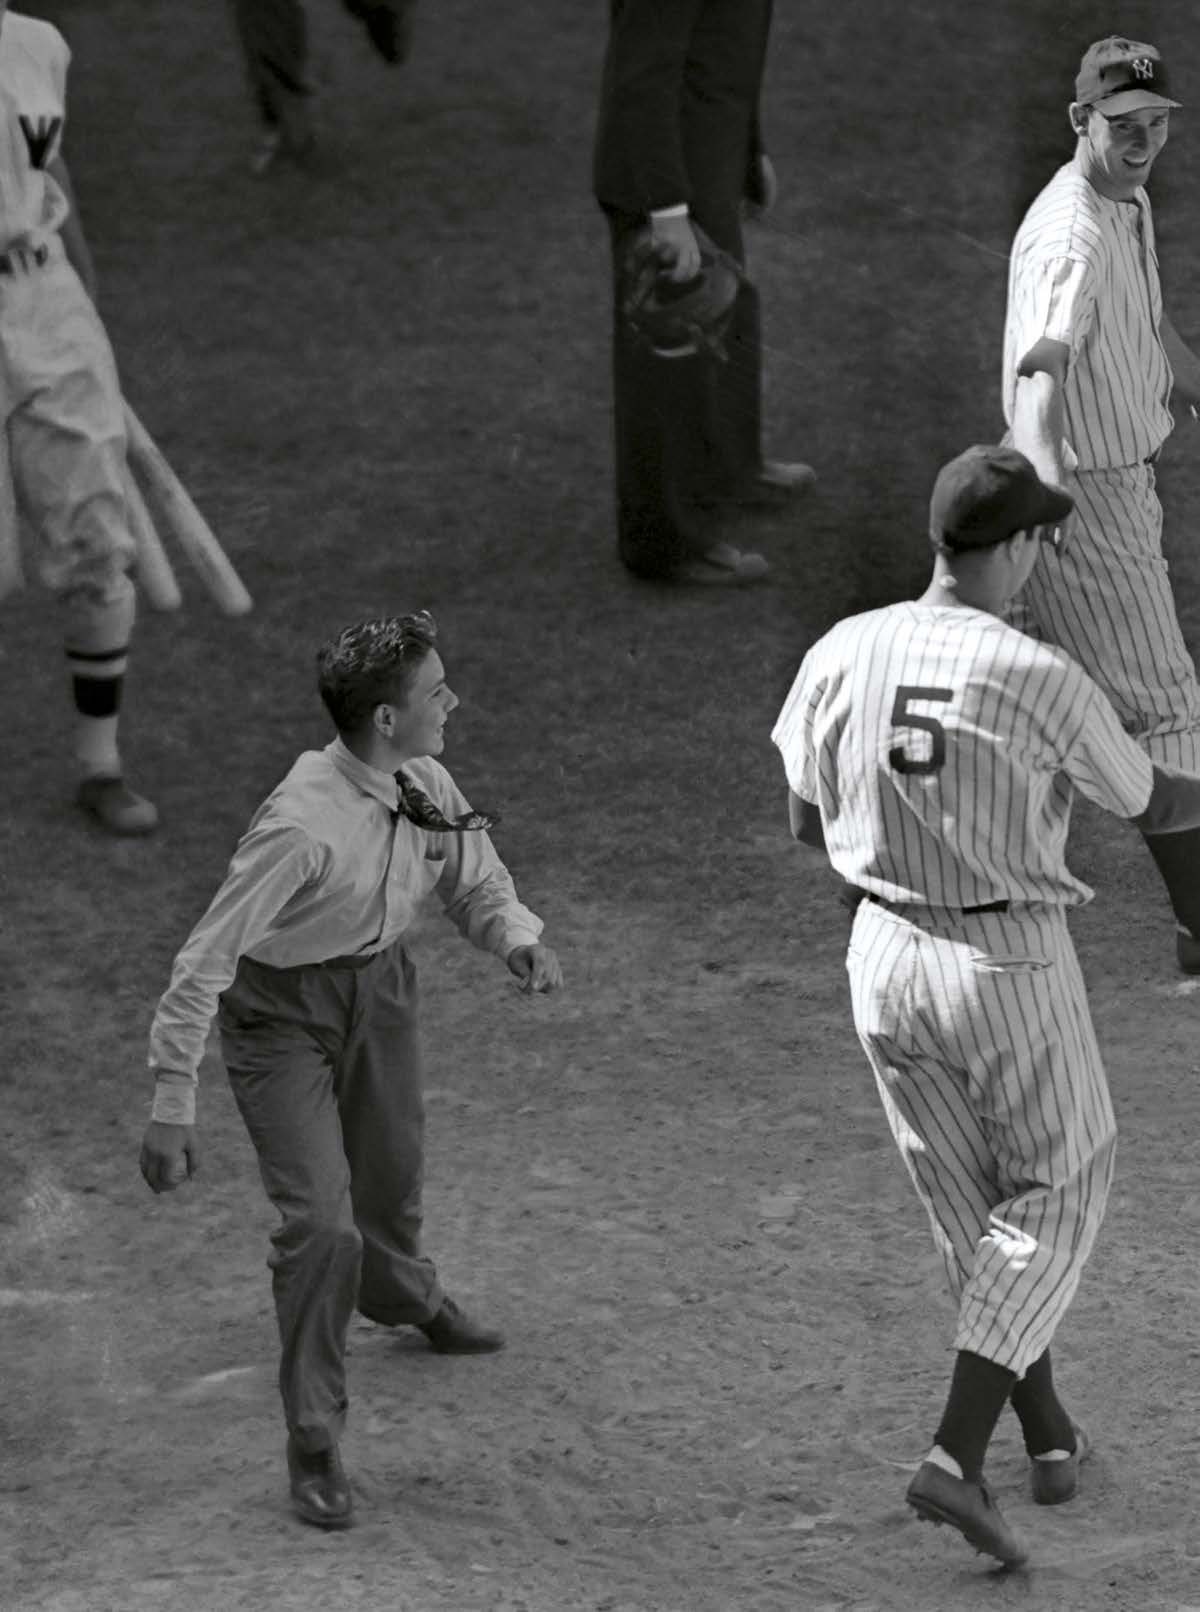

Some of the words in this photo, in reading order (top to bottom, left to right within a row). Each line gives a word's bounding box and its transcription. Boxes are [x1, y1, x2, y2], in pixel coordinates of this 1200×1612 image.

[1132, 58, 1154, 79] NY
[18, 114, 61, 170] W
[889, 685, 954, 775] 5
